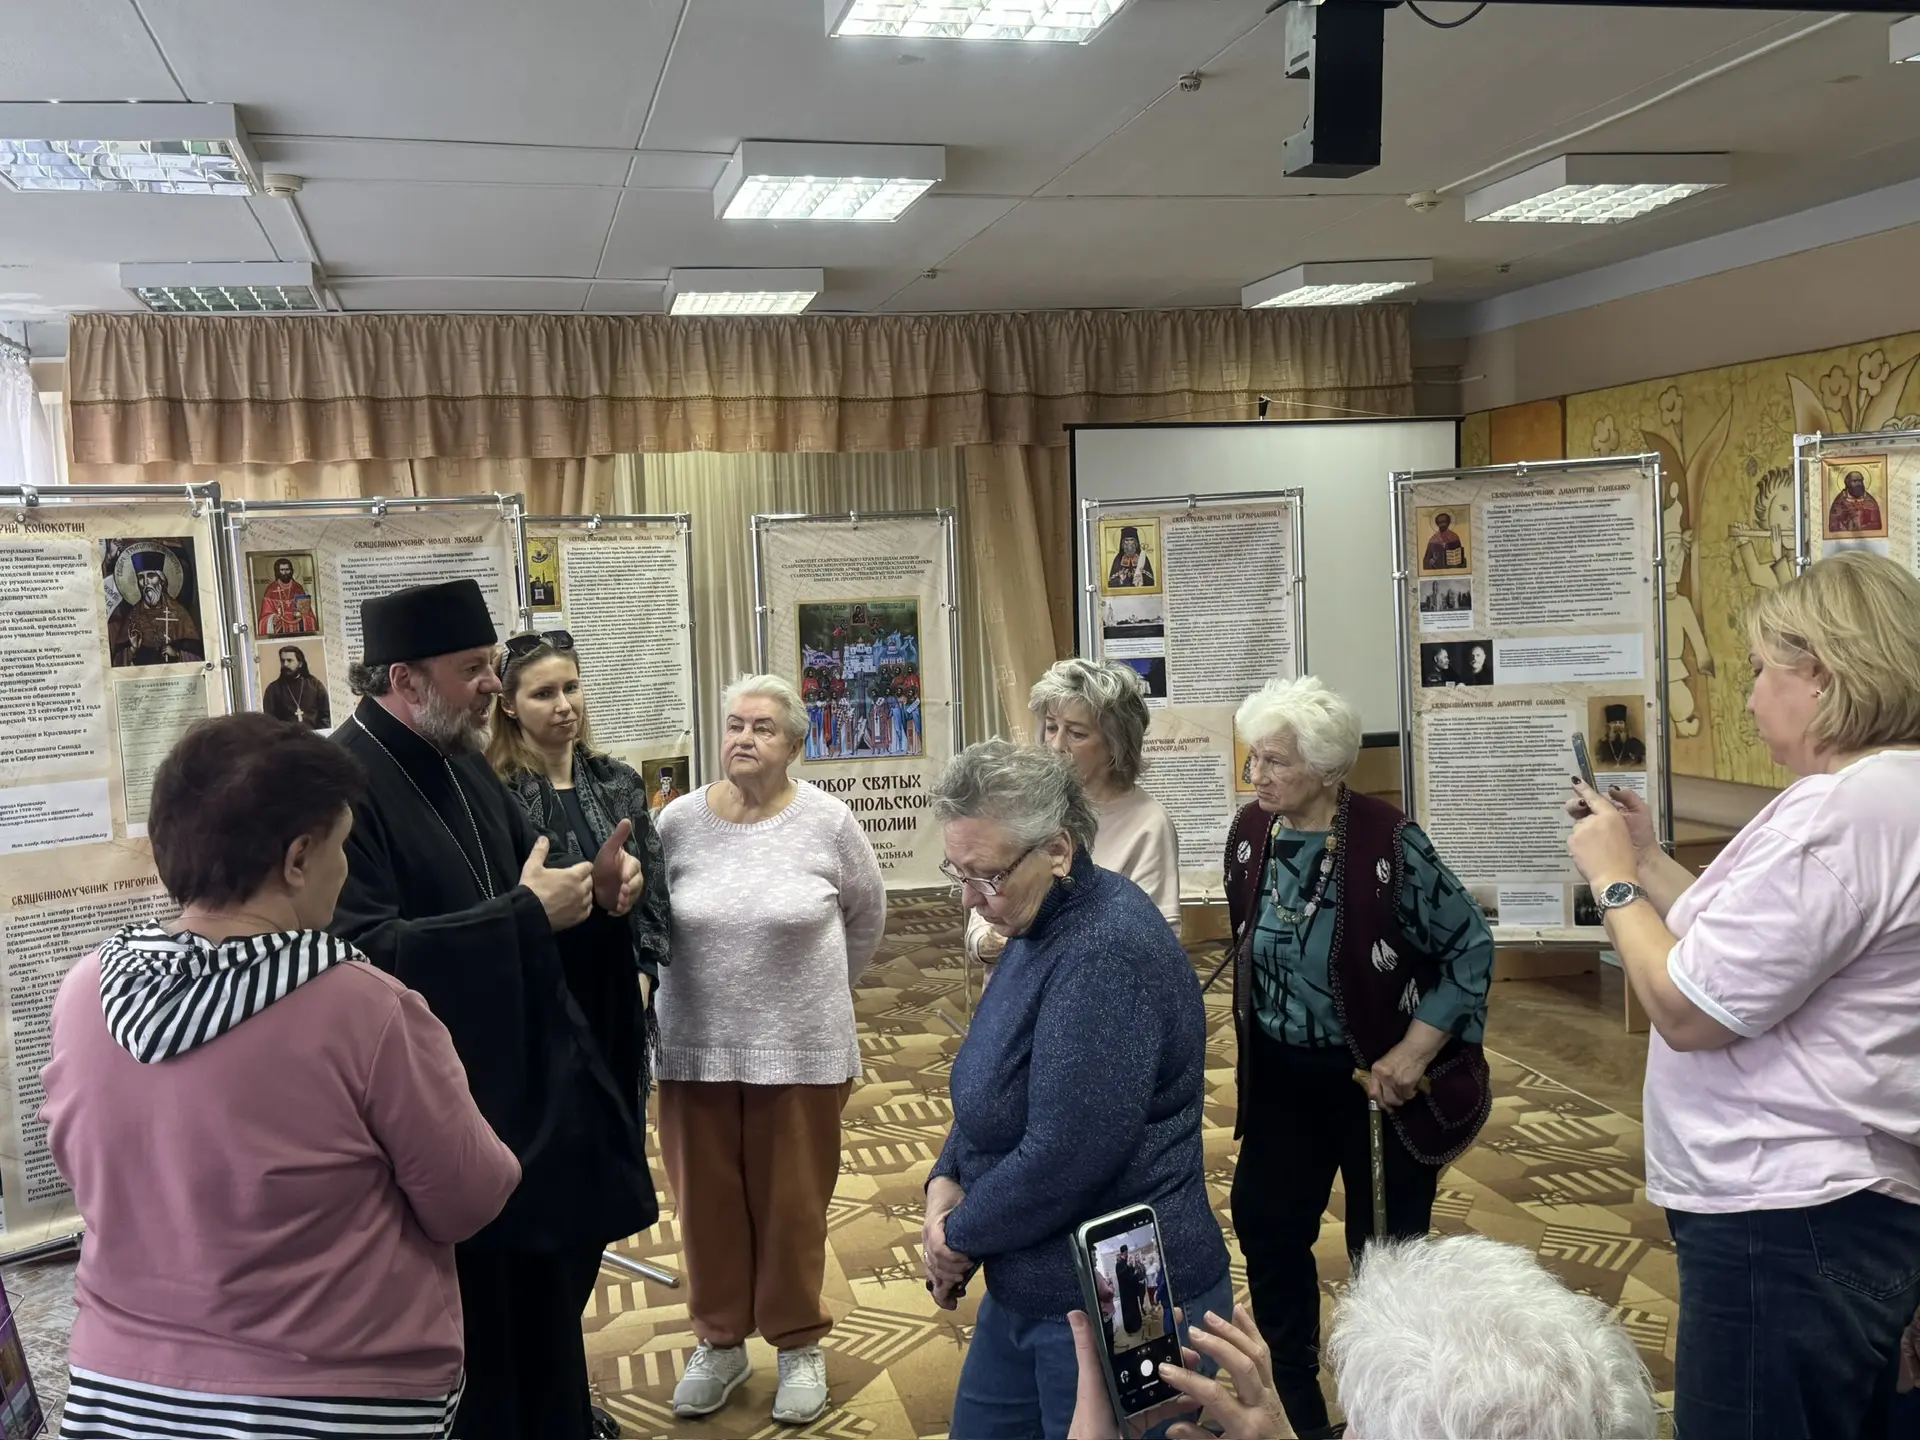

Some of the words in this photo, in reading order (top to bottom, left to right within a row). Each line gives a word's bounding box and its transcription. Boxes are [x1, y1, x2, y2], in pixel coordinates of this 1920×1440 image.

[24, 522, 85, 534] КОНОКОТИН
[12, 616, 48, 624] Кубанской
[38, 622, 77, 630] преподавал
[14, 632, 44, 640] училище
[46, 629, 92, 637] Министерства
[37, 653, 75, 661] работников
[16, 669, 52, 678] обвинений
[39, 684, 58, 692] собор
[59, 682, 82, 691] города
[33, 692, 70, 700] обвинению
[38, 706, 68, 715] сентября
[70, 704, 85, 712] 1921
[87, 703, 101, 711] года
[44, 713, 77, 723] расстрелу
[44, 729, 81, 738] Краснодаре
[15, 746, 56, 755] Священного
[58, 743, 81, 751] Синода
[16, 754, 36, 764] Собор
[38, 750, 88, 760] новомучеников
[862, 774, 921, 791] СВЯТЫХ
[12, 882, 108, 907] СВЯЩЕННОМУЧЕНИК
[114, 874, 158, 891] ГРИГОРИЙ
[14, 911, 40, 923] Родился
[47, 907, 75, 918] октября
[92, 903, 107, 912] года
[71, 911, 96, 922] Иосифа
[6, 921, 60, 939] Ставропольскую
[60, 916, 92, 930] духовную
[93, 912, 129, 924] семинарию
[7, 943, 42, 957] Кубанской
[20, 953, 28, 962] 24
[28, 949, 52, 960] августа
[69, 942, 83, 952] года
[9, 958, 44, 972] должность
[51, 951, 82, 963] Троицкой
[31, 972, 55, 983] августа
[11, 997, 43, 1007] сентября
[27, 1182, 55, 1195] Русской
